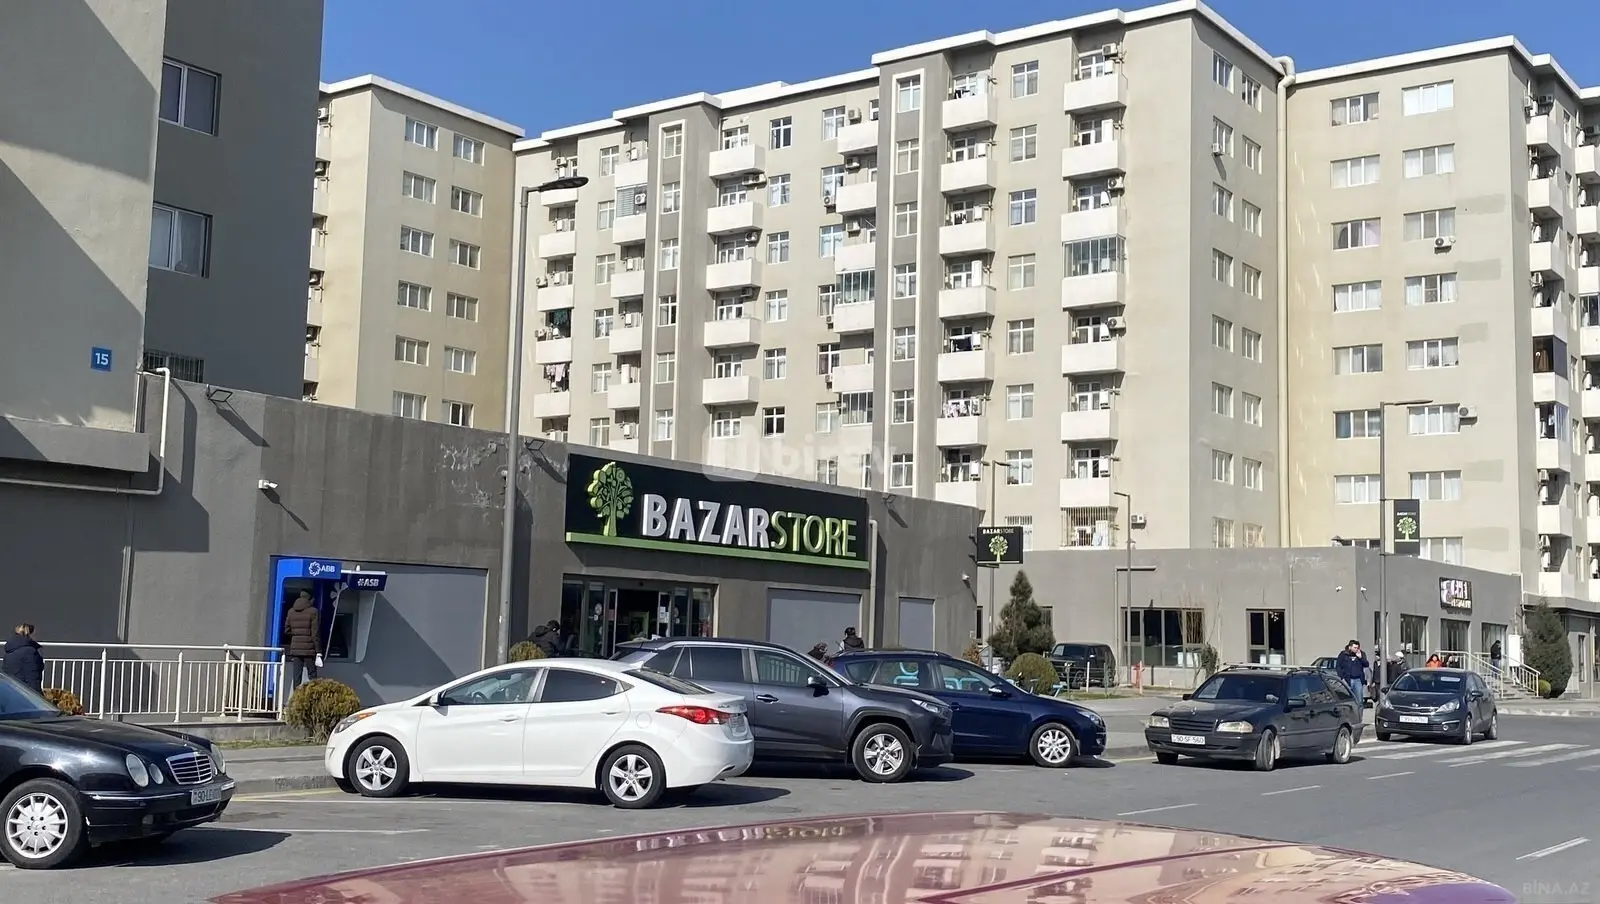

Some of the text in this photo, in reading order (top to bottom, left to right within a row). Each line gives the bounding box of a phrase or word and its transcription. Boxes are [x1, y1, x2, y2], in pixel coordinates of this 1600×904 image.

[95, 352, 109, 365] 15
[641, 493, 857, 558] BAZARSTORE
[320, 565, 335, 573] ABB
